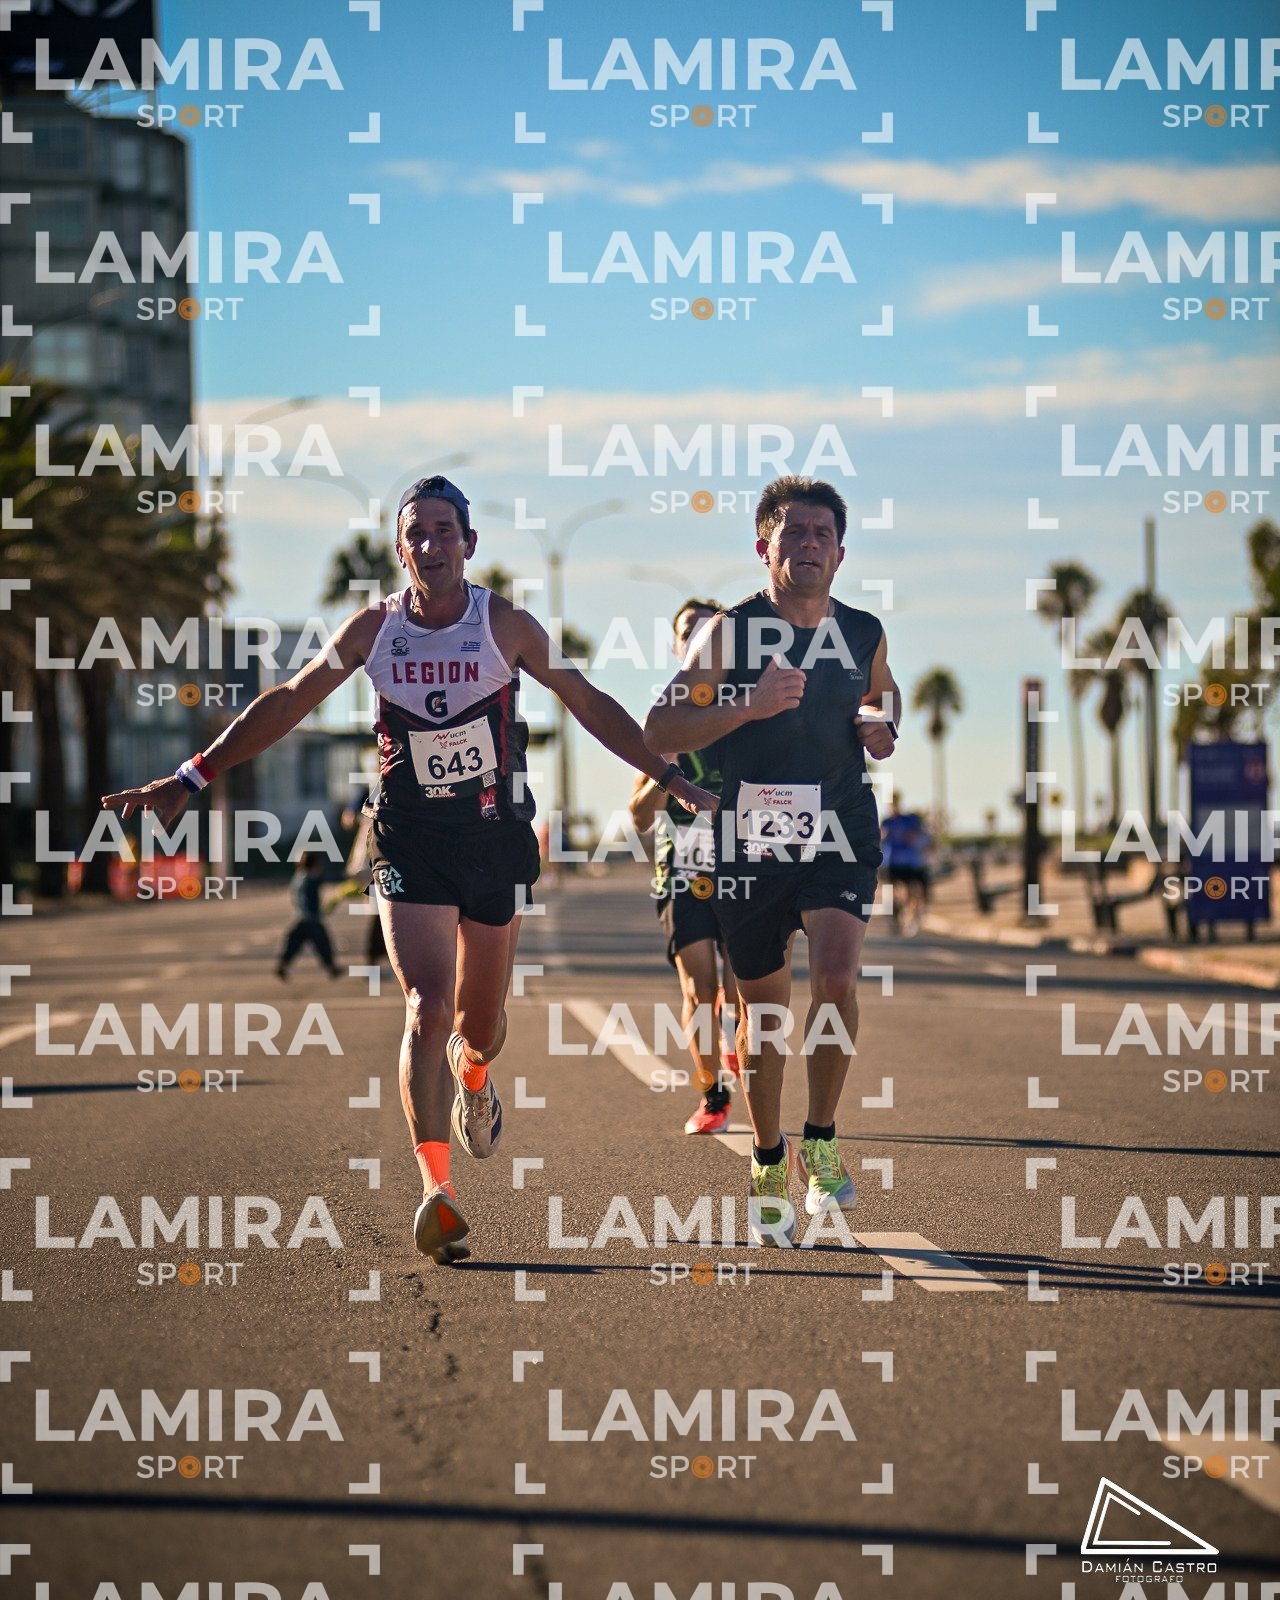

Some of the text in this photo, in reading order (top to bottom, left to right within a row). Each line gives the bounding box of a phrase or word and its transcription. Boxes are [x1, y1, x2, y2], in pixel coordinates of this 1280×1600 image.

[392, 661, 479, 685] LEGION
[425, 689, 449, 718] G
[449, 738, 468, 747] FALCK
[427, 746, 483, 780] 643
[742, 808, 815, 839] 1233
